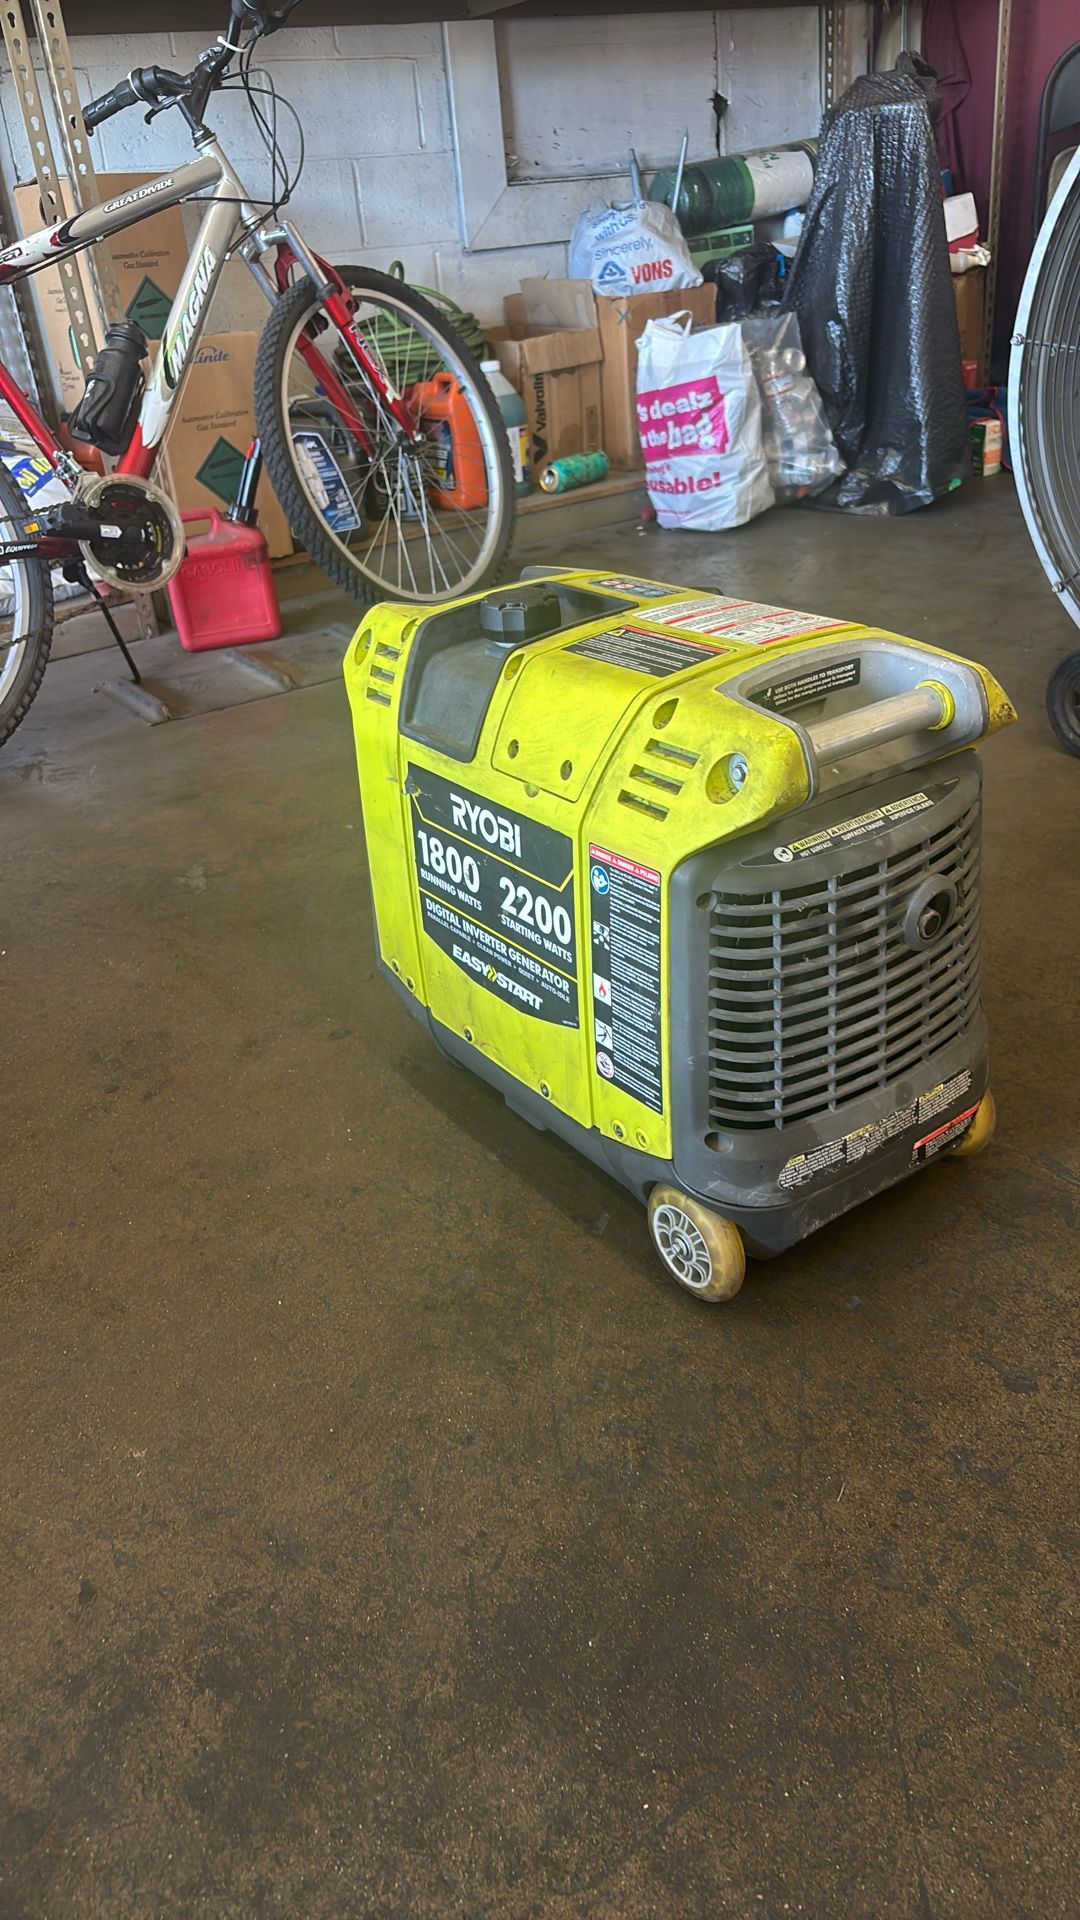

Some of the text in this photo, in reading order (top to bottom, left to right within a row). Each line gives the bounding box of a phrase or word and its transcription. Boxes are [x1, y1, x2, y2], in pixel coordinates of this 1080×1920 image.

[103, 177, 174, 213] GREAT DIVIDE
[595, 222, 619, 241] with
[631, 258, 673, 284] VONS
[170, 243, 216, 382] MAGNA
[533, 374, 547, 432] Valvolin
[649, 390, 713, 420] dealz
[667, 413, 716, 450] bag
[819, 671, 826, 679] TO
[826, 663, 854, 677] TRANSPORT
[449, 792, 522, 858] RYOBI
[798, 794, 925, 848] WARNING AVERTISSEMENT ADVERTENCIA
[417, 830, 480, 893] 1800
[799, 848, 811, 859] HOT
[811, 841, 833, 855] SURFACE
[420, 868, 483, 911] RUNNING WATTS
[499, 876, 572, 945] 2200
[425, 898, 570, 994] DIGITAL INVERTER GENERATOR
[501, 916, 573, 964] STARTING WATTS
[452, 943, 544, 1010] EASY START
[476, 941, 493, 956] CLEAN
[493, 952, 512, 967] POWER
[518, 967, 535, 981] QUIET
[541, 981, 570, 1004] AUTO-IDLE
